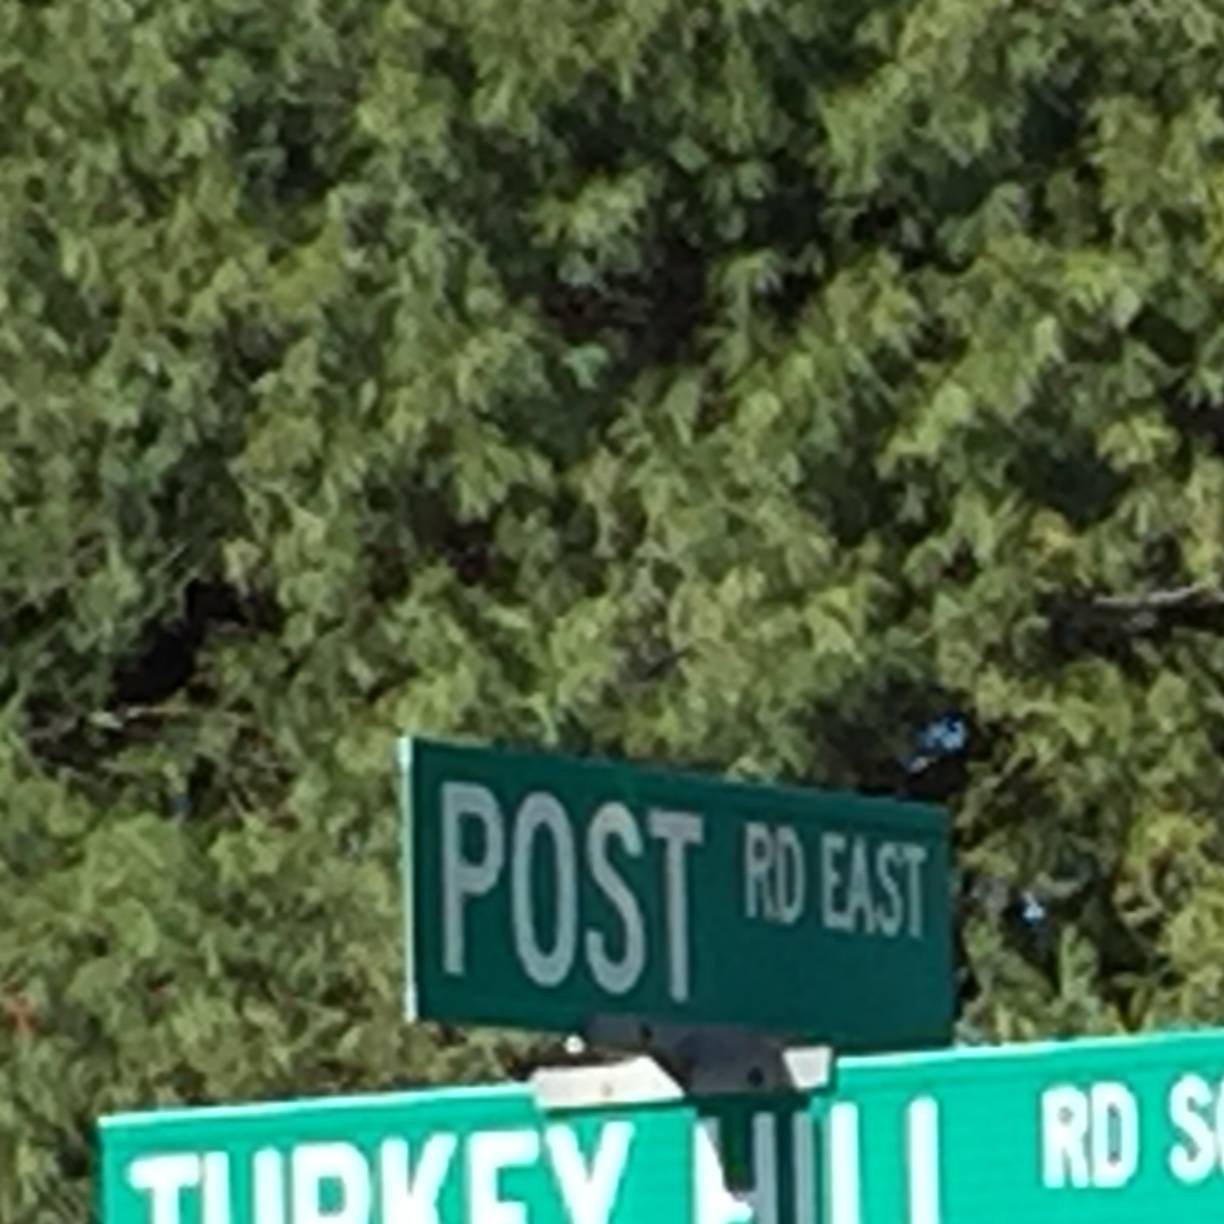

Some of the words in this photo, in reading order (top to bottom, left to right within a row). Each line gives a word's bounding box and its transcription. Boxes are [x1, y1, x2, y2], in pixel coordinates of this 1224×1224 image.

[440, 780, 704, 1003] POST
[744, 821, 802, 925] RD
[820, 831, 928, 939] EAST
[1041, 1081, 1140, 1190] RD
